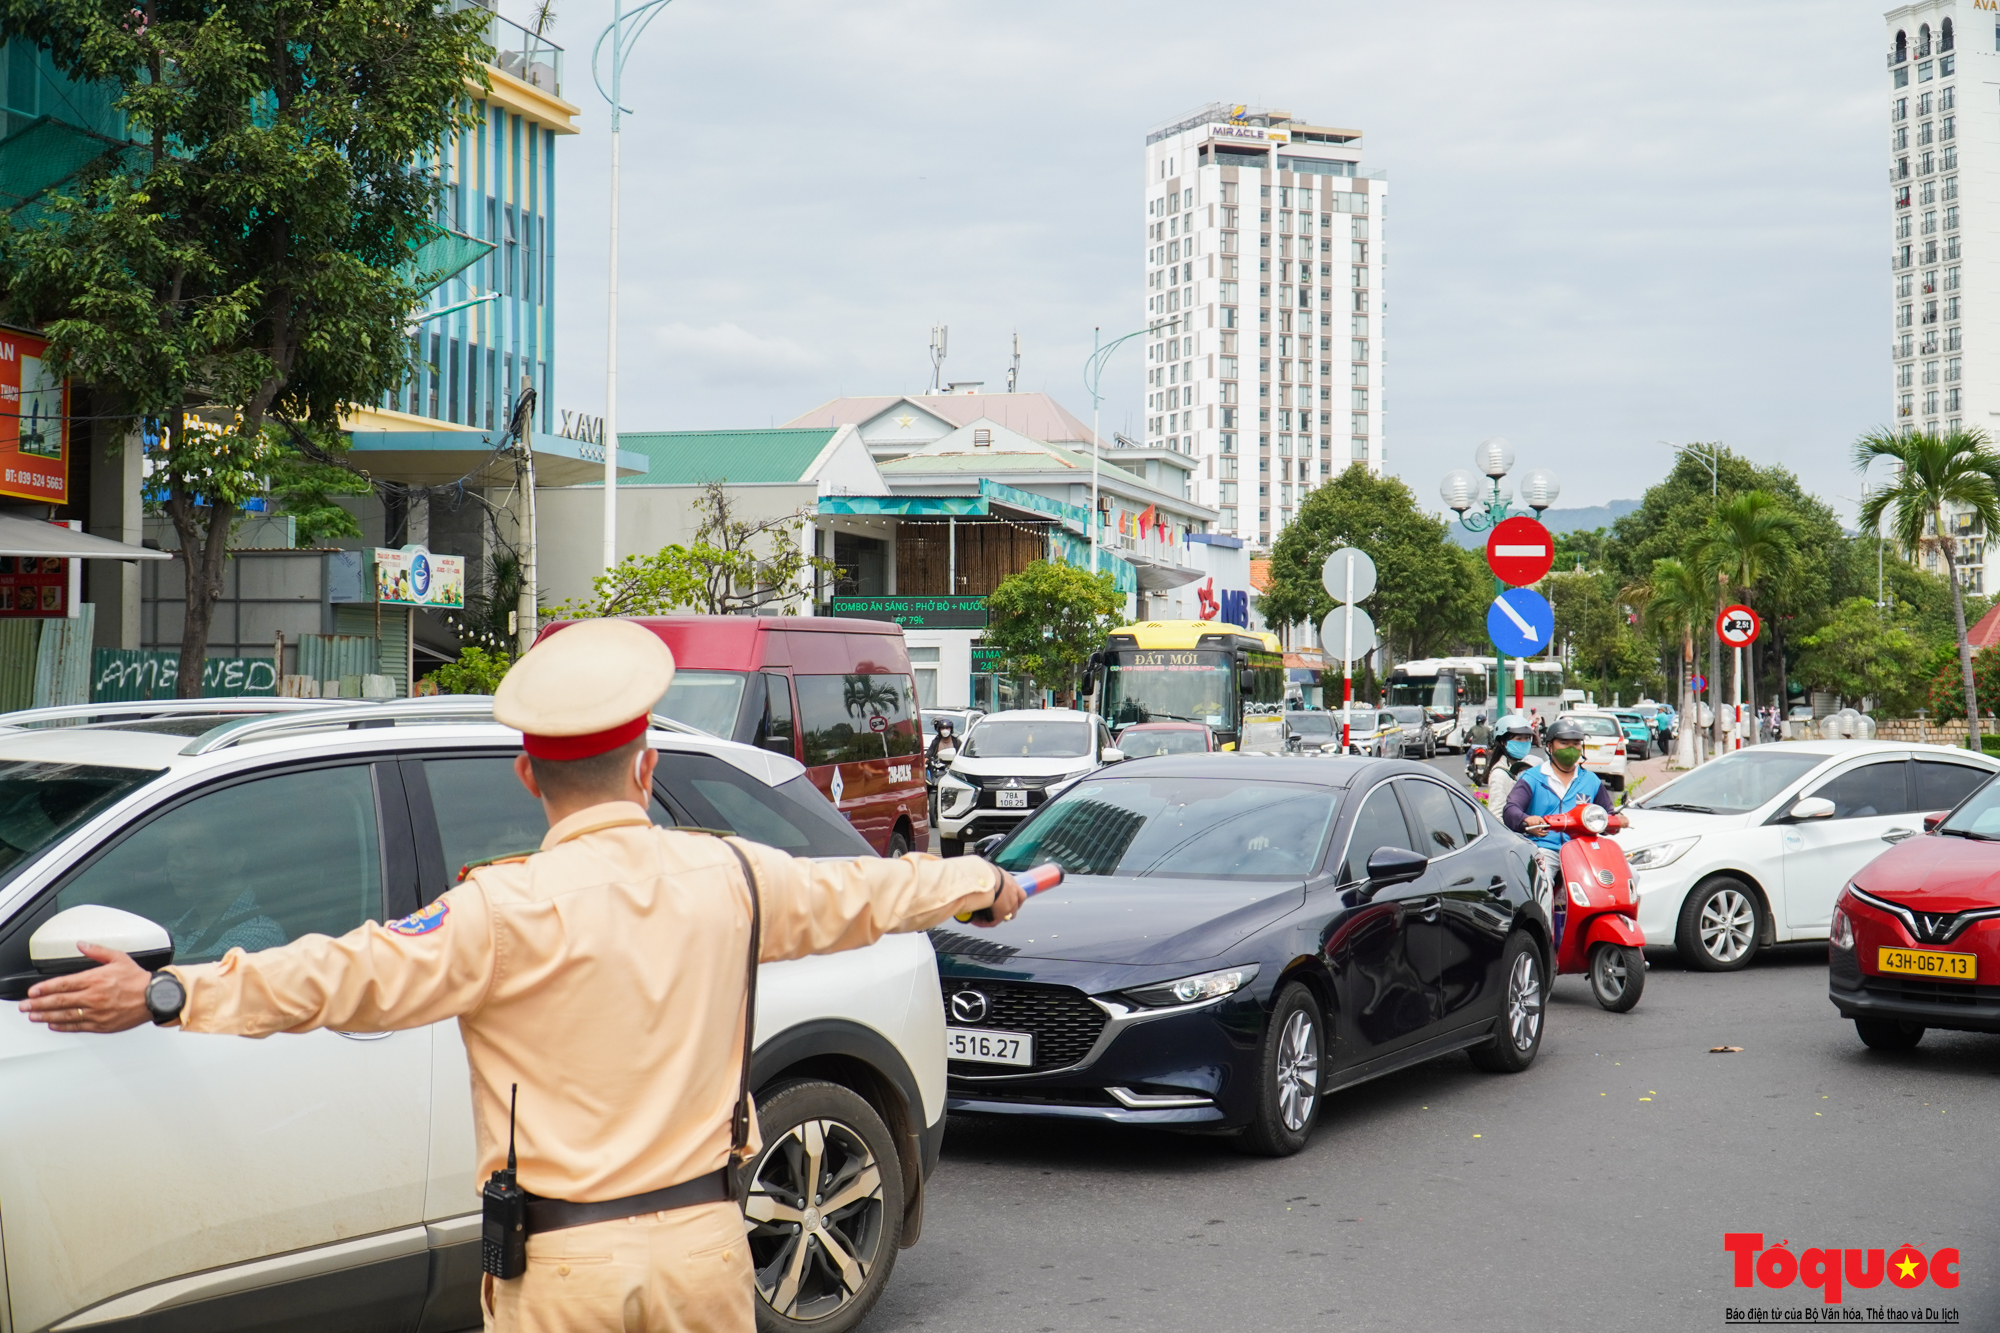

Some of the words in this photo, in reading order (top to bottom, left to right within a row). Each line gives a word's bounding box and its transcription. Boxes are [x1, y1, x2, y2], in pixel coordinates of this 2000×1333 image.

[1213, 127, 1264, 138] MIRACLE
[561, 409, 620, 449] XAVI
[18, 470, 31, 485] 039
[32, 473, 45, 487] 524
[46, 475, 63, 490] 5663
[834, 602, 868, 612] COMBO
[869, 601, 883, 612] ĂN
[884, 600, 909, 612] SÁNG
[915, 600, 936, 611] PHỞ
[936, 600, 950, 611] BÒ
[959, 600, 986, 611] NƯỚC
[1221, 589, 1248, 629] MB
[908, 615, 924, 625] 79k
[1736, 620, 1749, 629] 2,5t
[1134, 651, 1165, 665] ĐẤT
[1169, 651, 1198, 665] MỚI
[1000, 799, 1025, 807] 108.25
[1886, 952, 1967, 975] 43H-067.13
